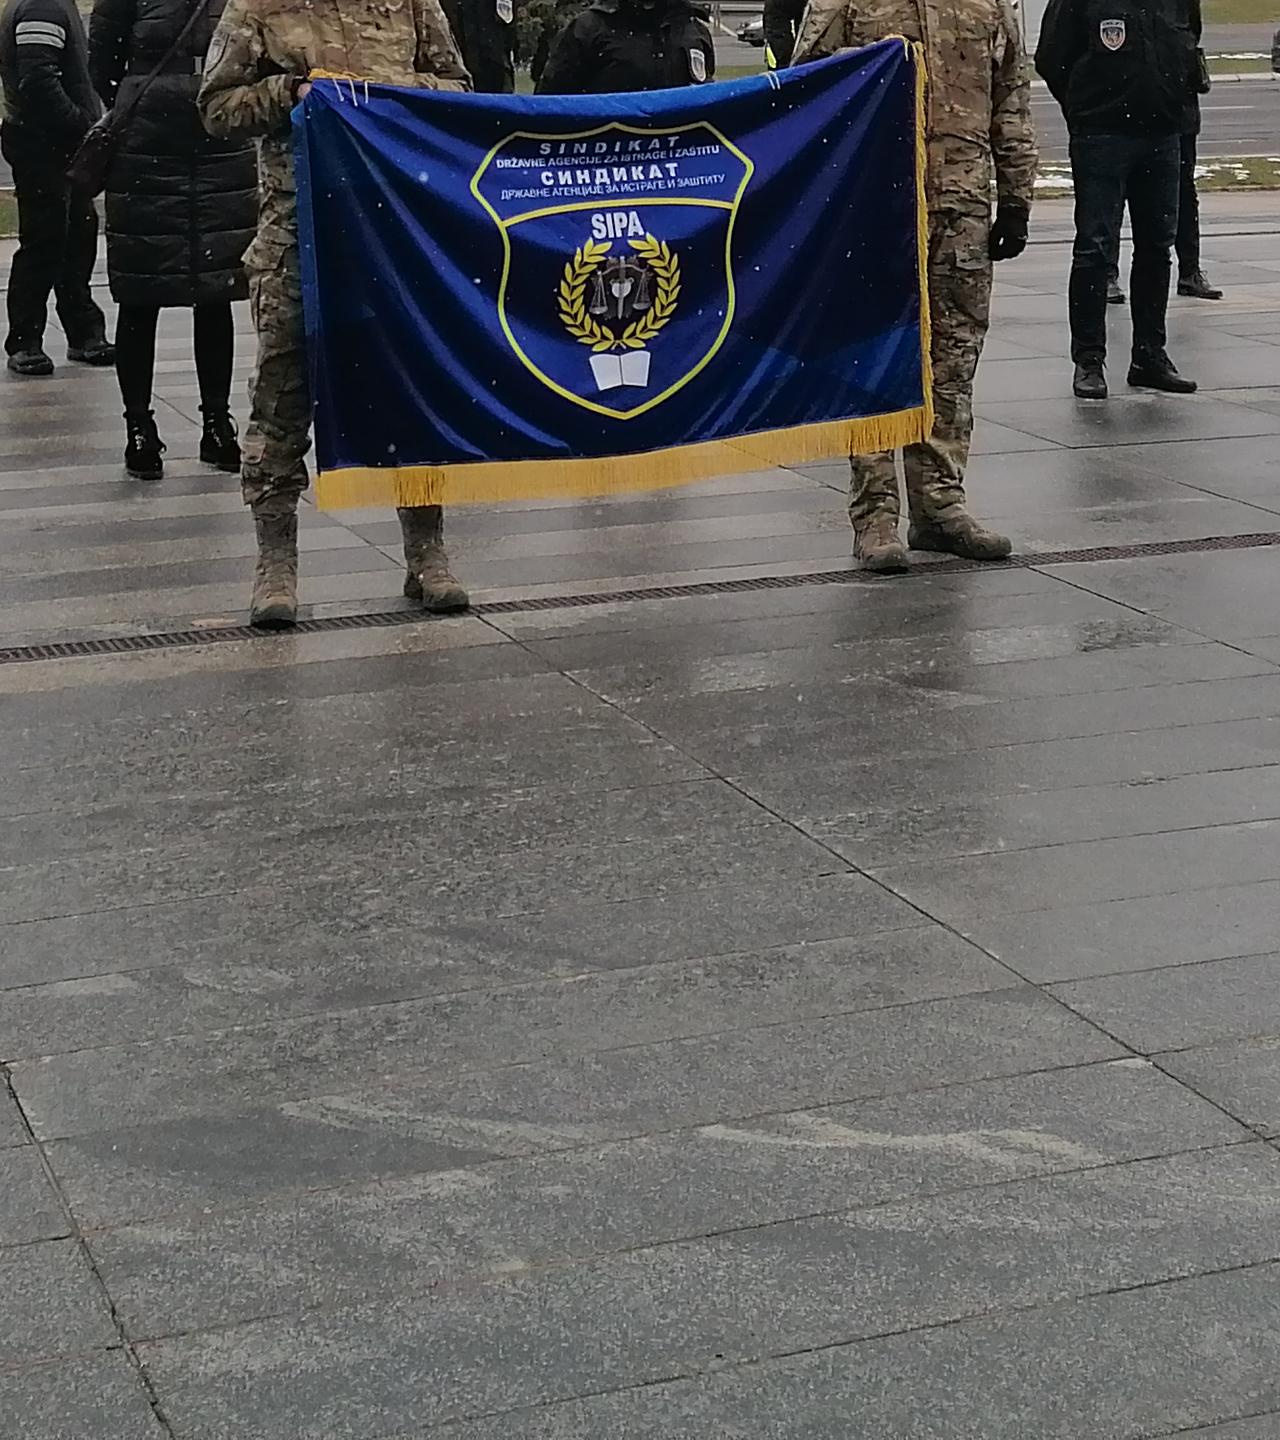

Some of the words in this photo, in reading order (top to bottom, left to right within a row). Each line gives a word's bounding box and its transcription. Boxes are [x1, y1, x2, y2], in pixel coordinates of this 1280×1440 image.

[496, 157, 546, 169] DRŽAVNE
[548, 155, 602, 167] AGENCIJE
[604, 154, 618, 163] ZA
[621, 150, 666, 162] ISTRAGE
[675, 144, 720, 158] ZAŠTITU
[540, 136, 679, 155] SINDIKAT
[541, 162, 679, 186] СИНДИКАТ
[501, 187, 550, 200] ДРЖАВНЕ
[552, 184, 604, 197] АГЕНЦИЈЕ
[606, 184, 620, 194] ЗА
[621, 180, 666, 193] ИСТРАГЕ
[667, 179, 676, 189] И
[677, 174, 726, 188] ЗАШТИТУ
[591, 211, 644, 240] SIPA
